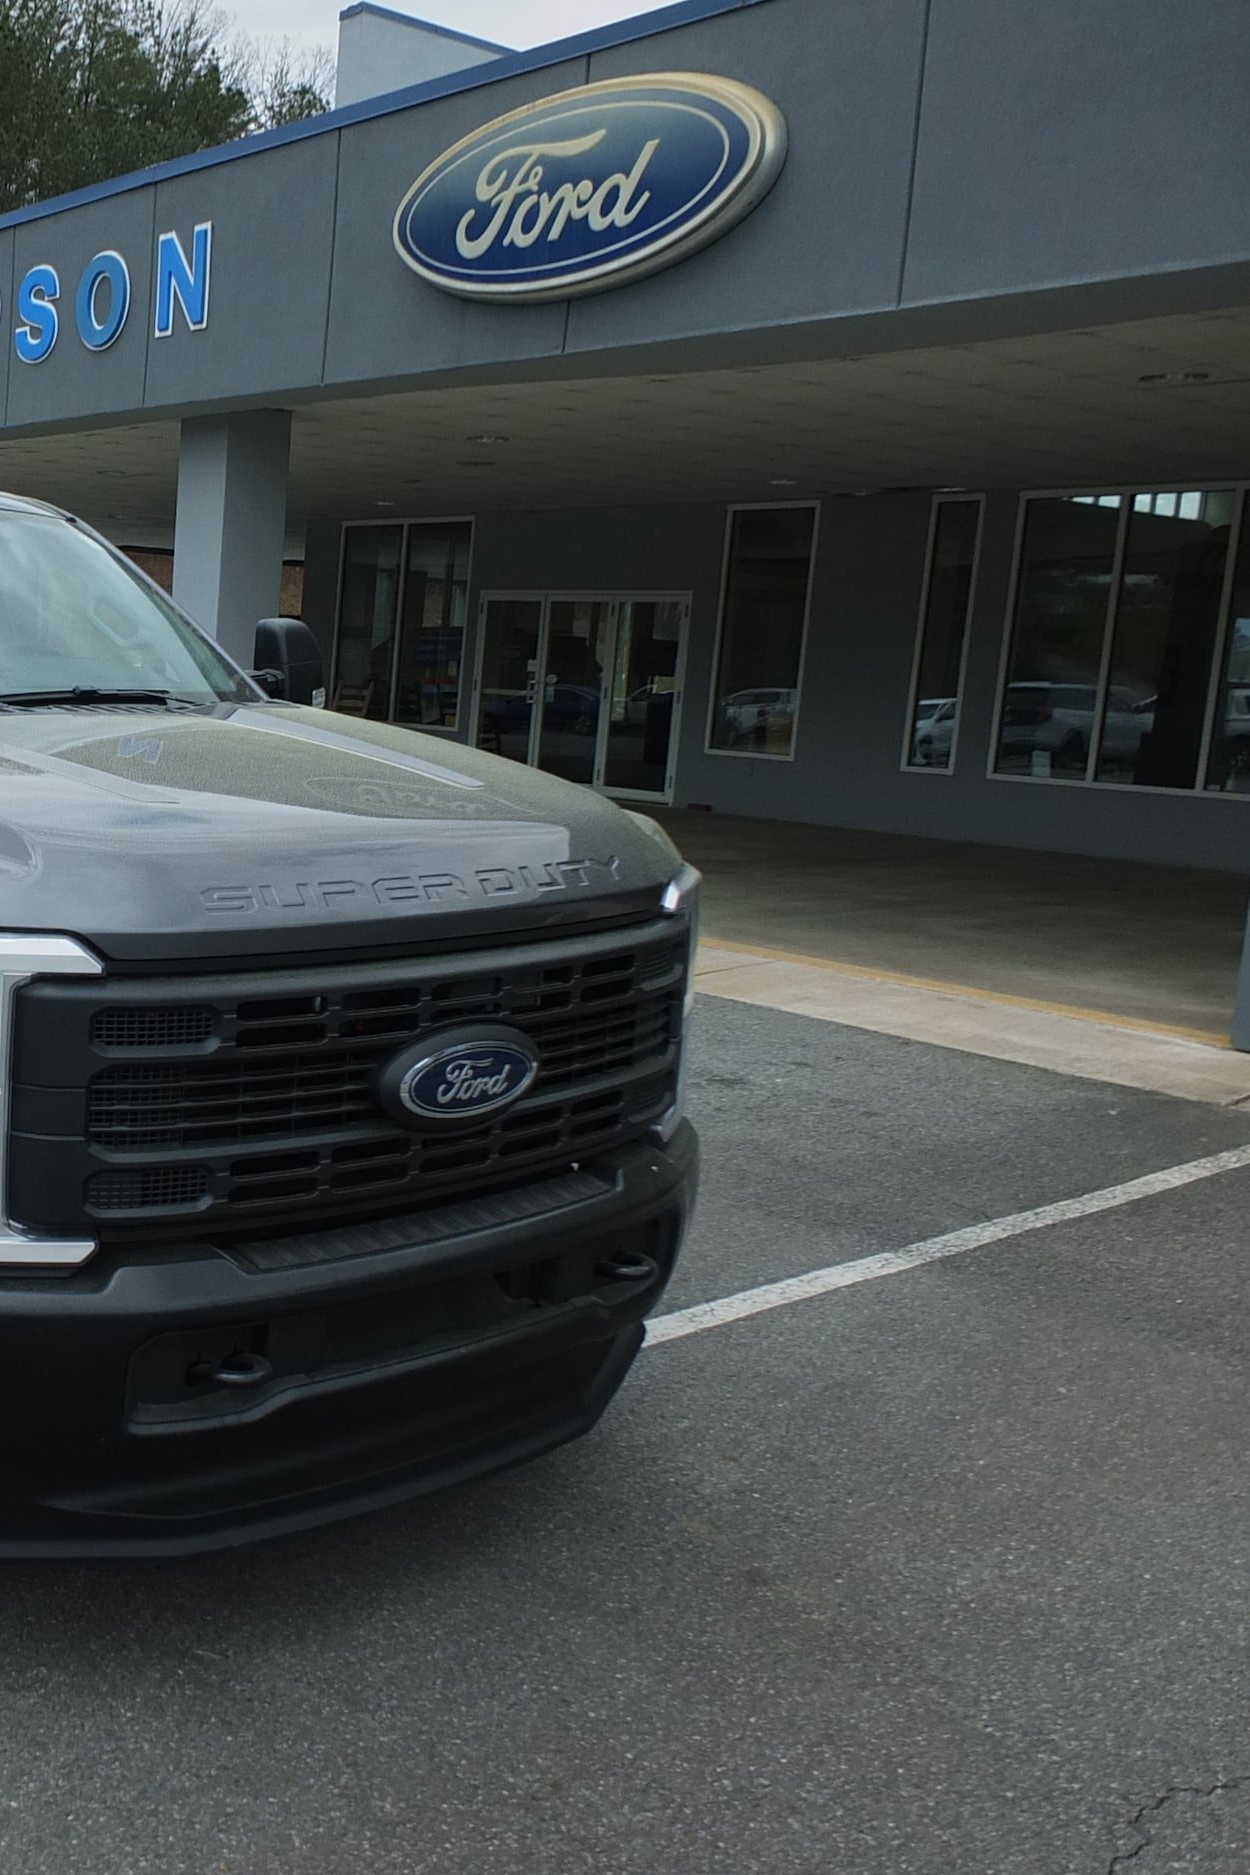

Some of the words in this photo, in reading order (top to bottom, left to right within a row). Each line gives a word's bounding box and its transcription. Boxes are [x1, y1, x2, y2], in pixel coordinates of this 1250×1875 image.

[456, 128, 660, 260] Ford
[199, 873, 470, 914] SUPER
[474, 855, 621, 896] DUTY
[436, 1057, 511, 1104] Ford
